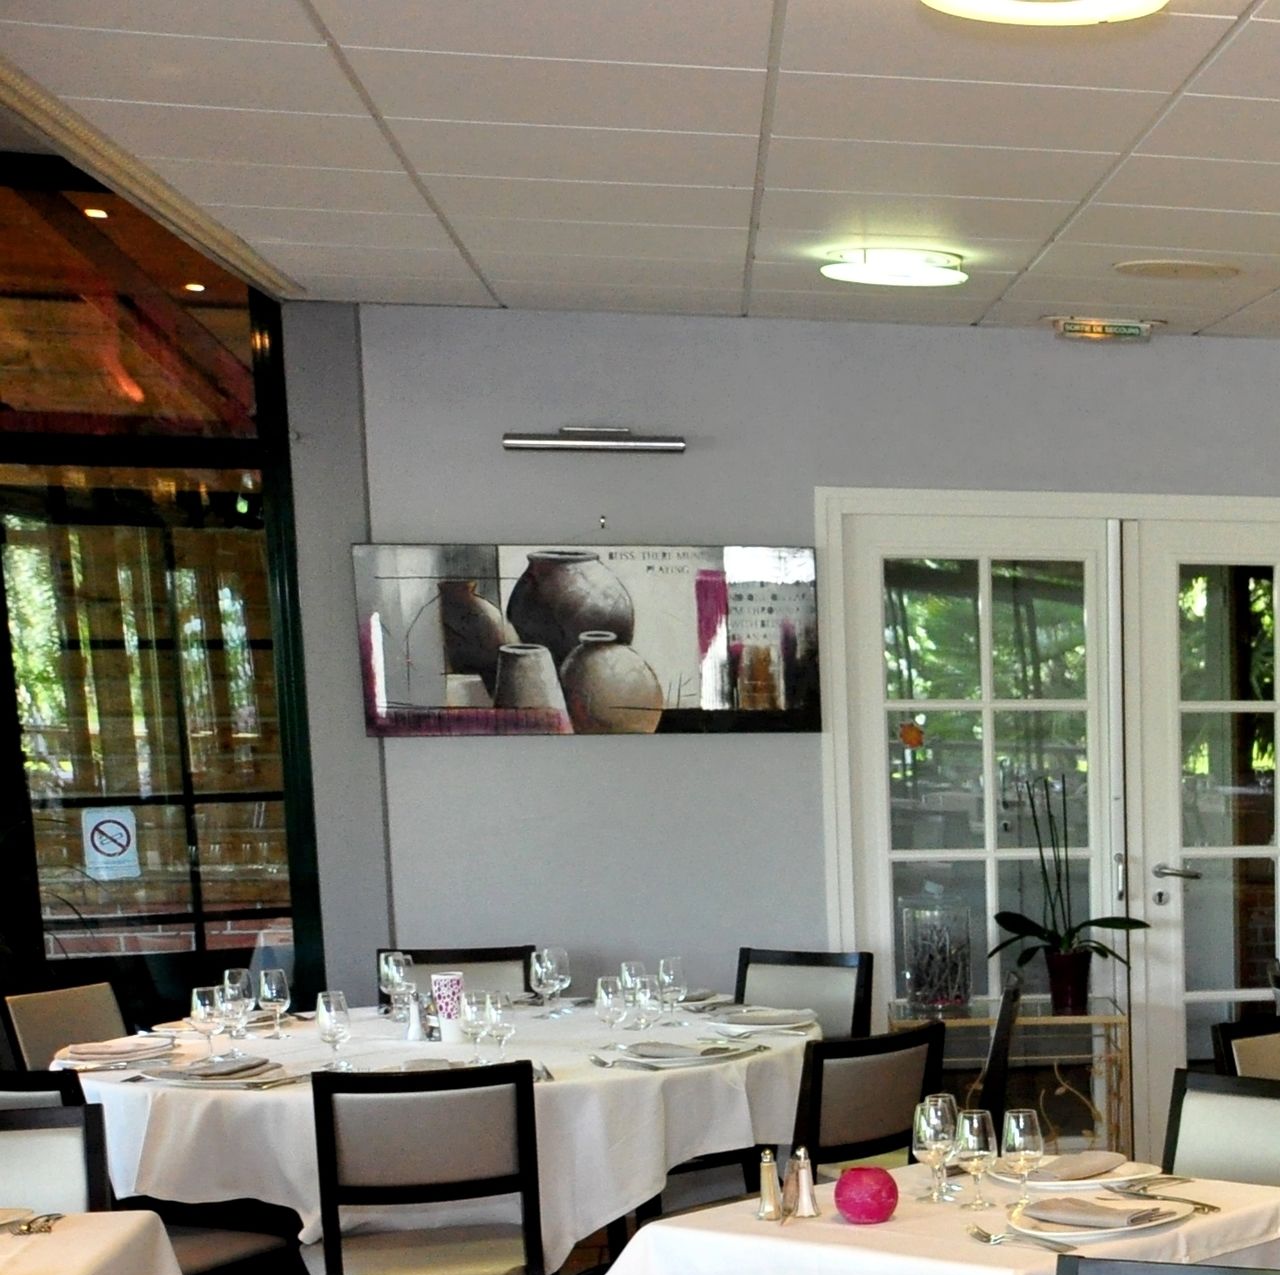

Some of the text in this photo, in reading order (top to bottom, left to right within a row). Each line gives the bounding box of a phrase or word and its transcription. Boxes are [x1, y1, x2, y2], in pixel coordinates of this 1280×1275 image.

[1065, 323, 1140, 335] SORTIE DE SECOURS
